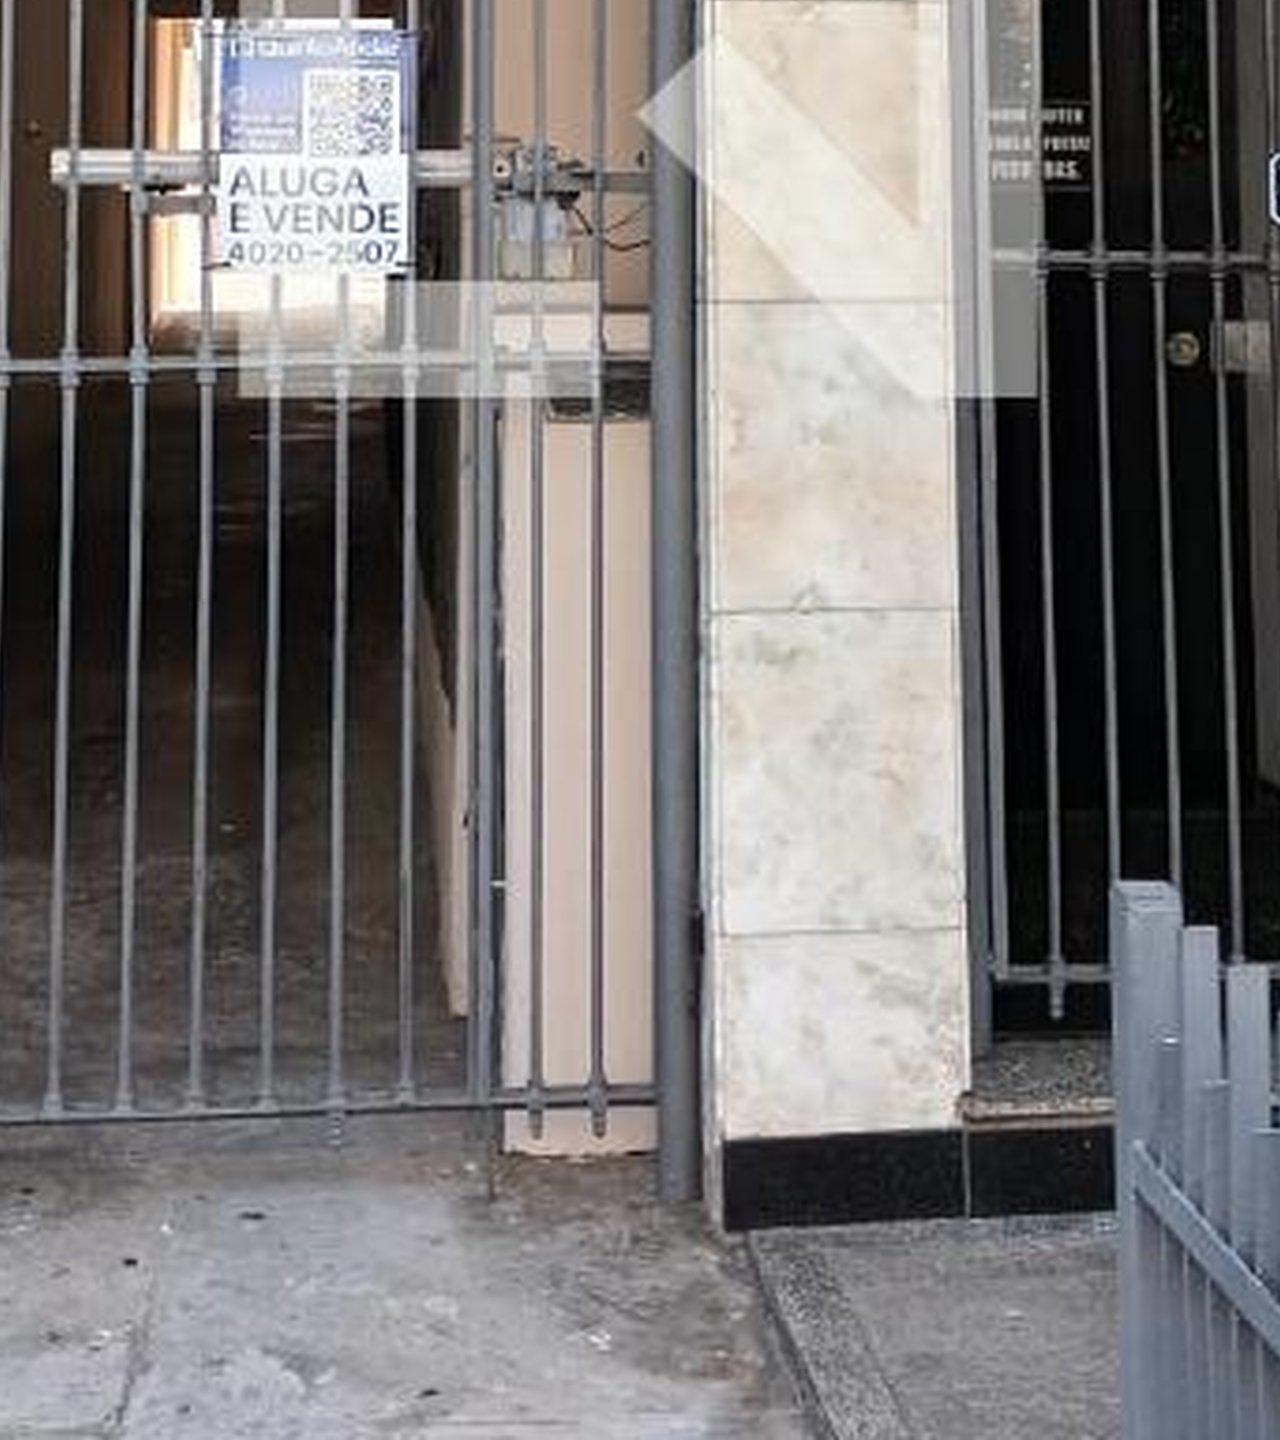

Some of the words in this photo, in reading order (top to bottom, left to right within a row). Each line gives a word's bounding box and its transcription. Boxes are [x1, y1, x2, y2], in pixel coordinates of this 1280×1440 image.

[229, 166, 369, 198] ALUGA
[229, 203, 251, 233] E
[264, 202, 402, 234] VENDE
